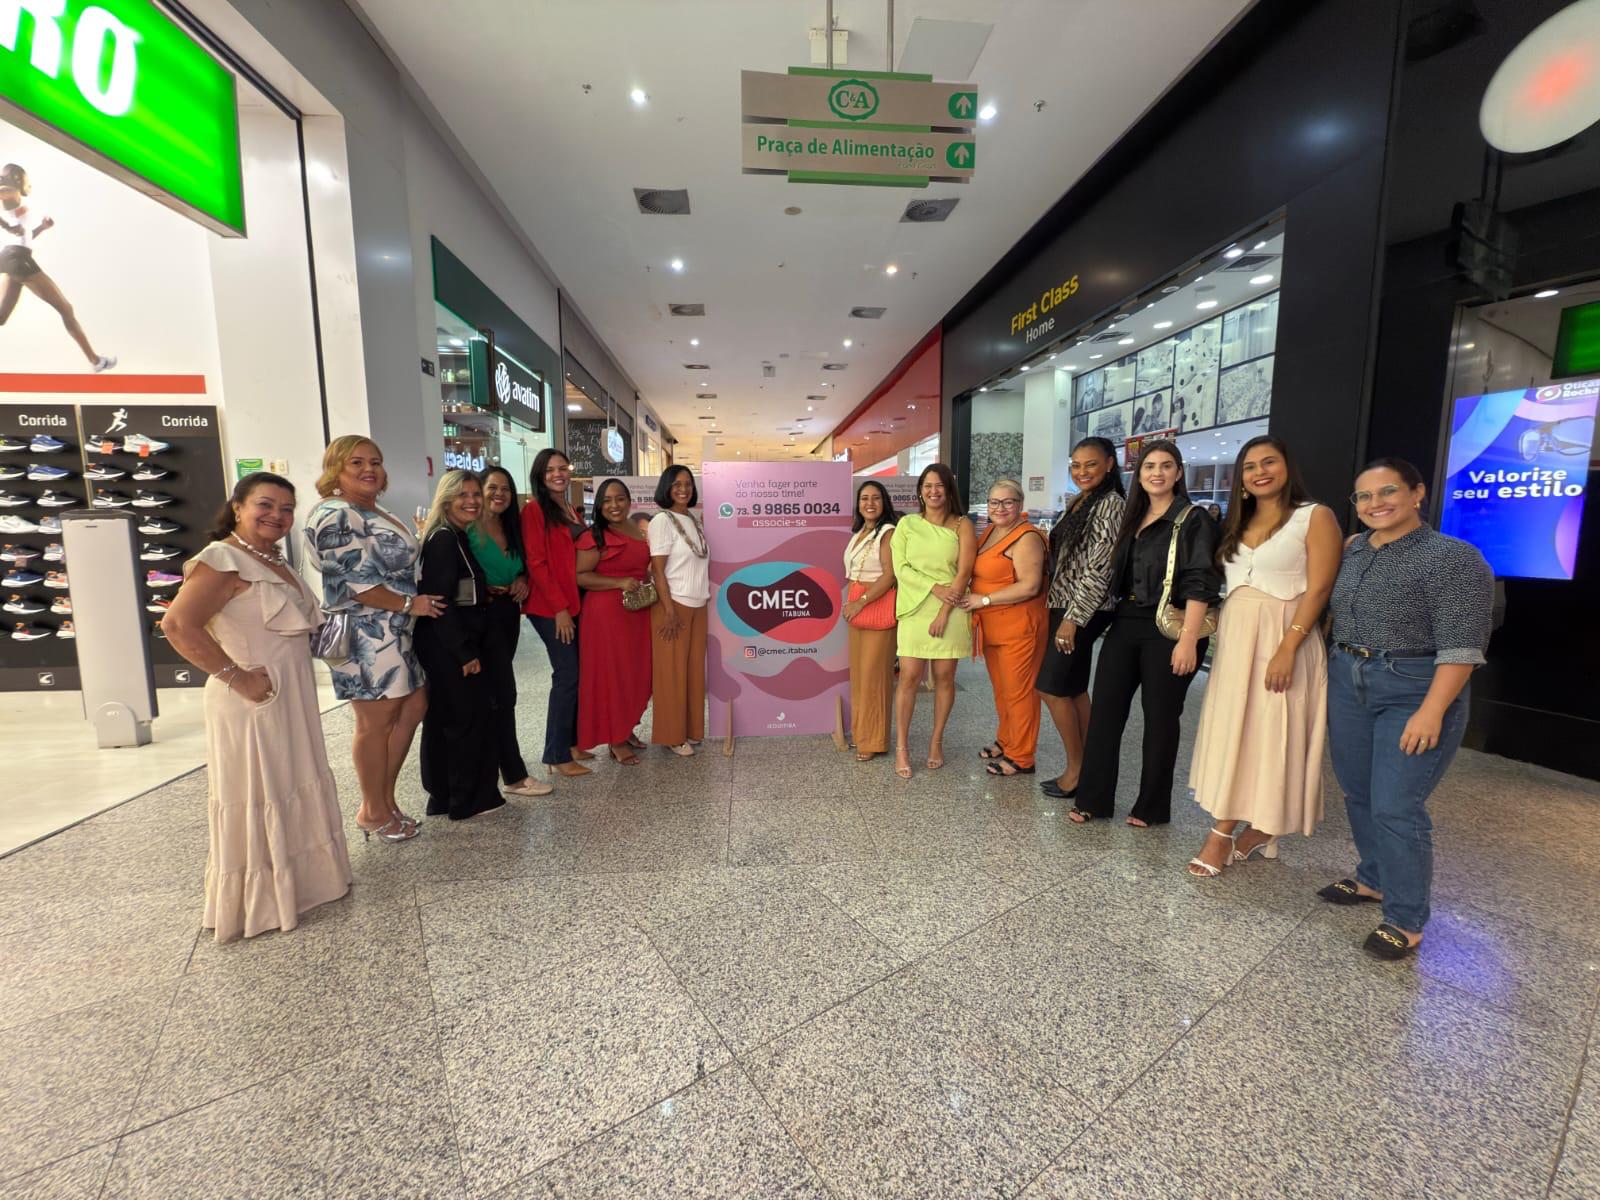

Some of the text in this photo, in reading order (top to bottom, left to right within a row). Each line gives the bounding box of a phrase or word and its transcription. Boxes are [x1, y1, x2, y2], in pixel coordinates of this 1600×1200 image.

[835, 90, 870, 109] C&A
[757, 135, 935, 162] Praça de Alimentação
[1011, 274, 1080, 336] First Class
[1026, 317, 1055, 344] Home
[512, 381, 540, 413] avatim
[18, 414, 67, 426] Corrida
[162, 415, 208, 427] Corrida
[1469, 467, 1567, 484] Valorize
[735, 480, 818, 489] Venha fazer parte
[1452, 480, 1583, 499] seu estilo
[736, 489, 805, 498] do nosso time!
[752, 503, 761, 515] 9
[764, 503, 800, 515] 9865
[803, 502, 841, 514] 0034
[752, 518, 807, 527] associe-se
[747, 589, 809, 610] CMEC
[758, 647, 818, 656] @cmec.itabuna
